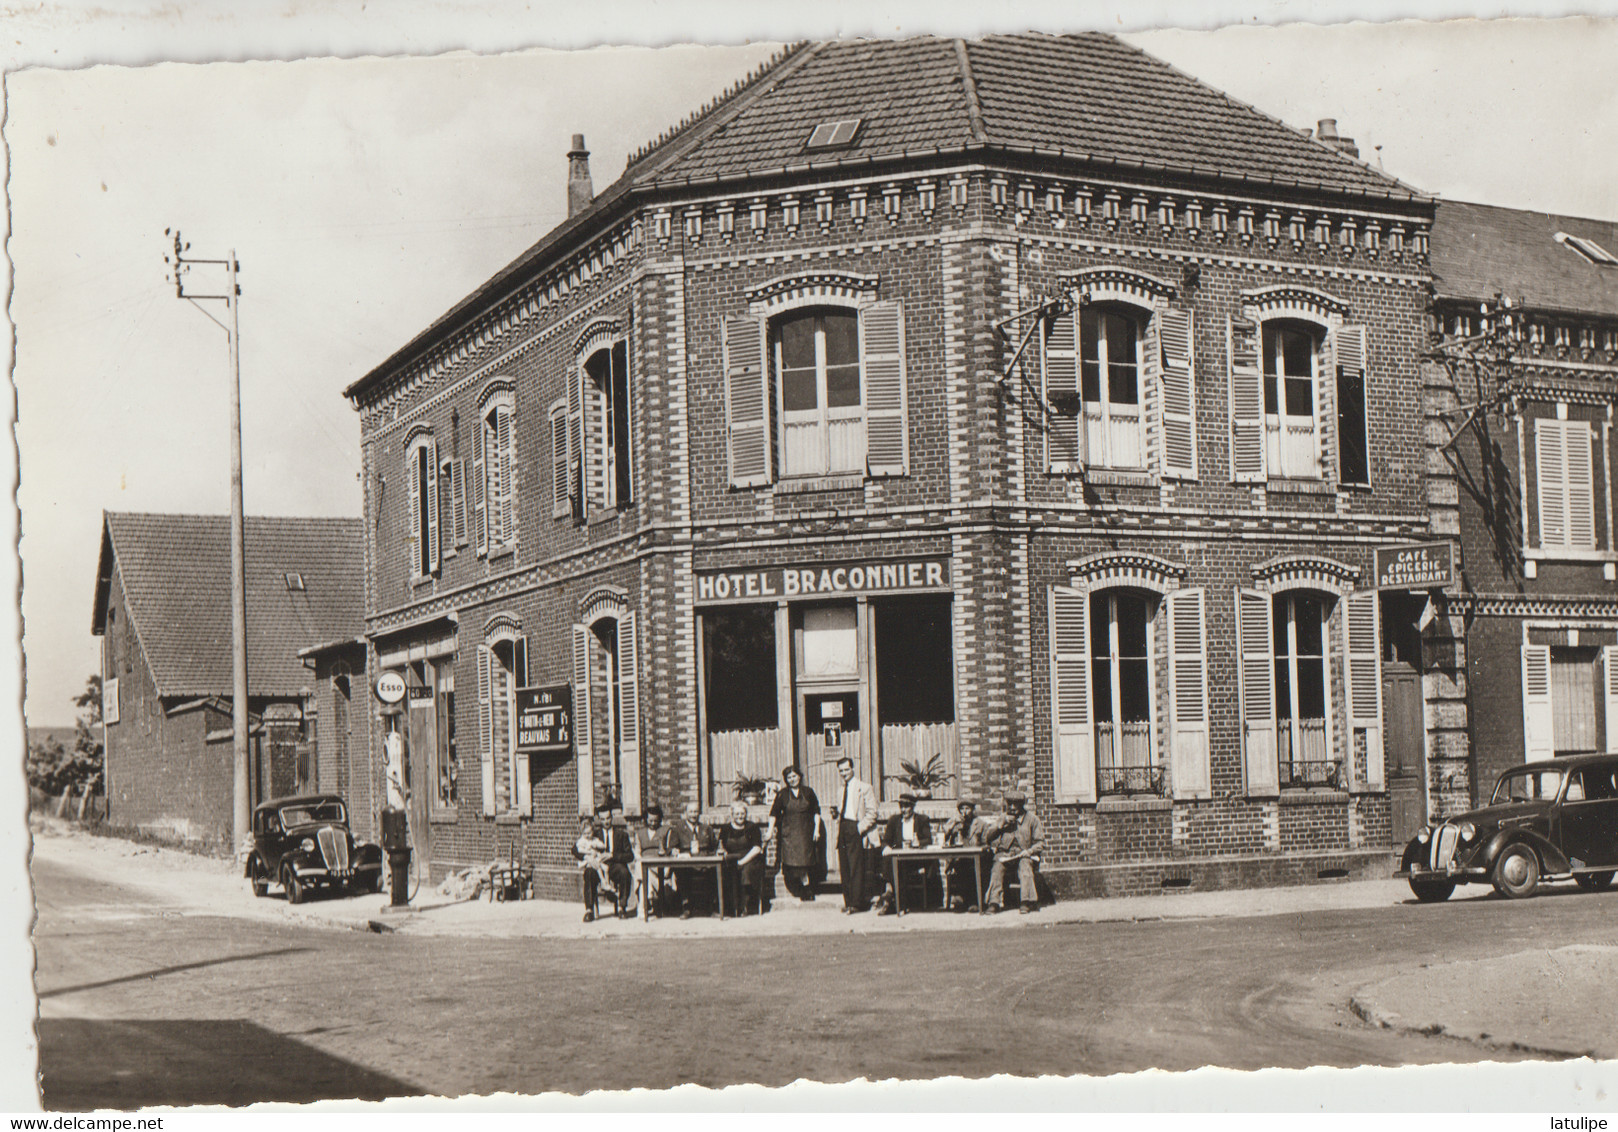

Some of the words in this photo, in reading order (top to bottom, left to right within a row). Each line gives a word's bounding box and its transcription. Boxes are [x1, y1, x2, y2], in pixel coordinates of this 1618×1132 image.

[699, 573, 776, 599] HÔTEL
[783, 562, 944, 596] BRACONNIER
[1381, 569, 1448, 586] RESTAURANT
[519, 728, 551, 744] BEAUVAIS
